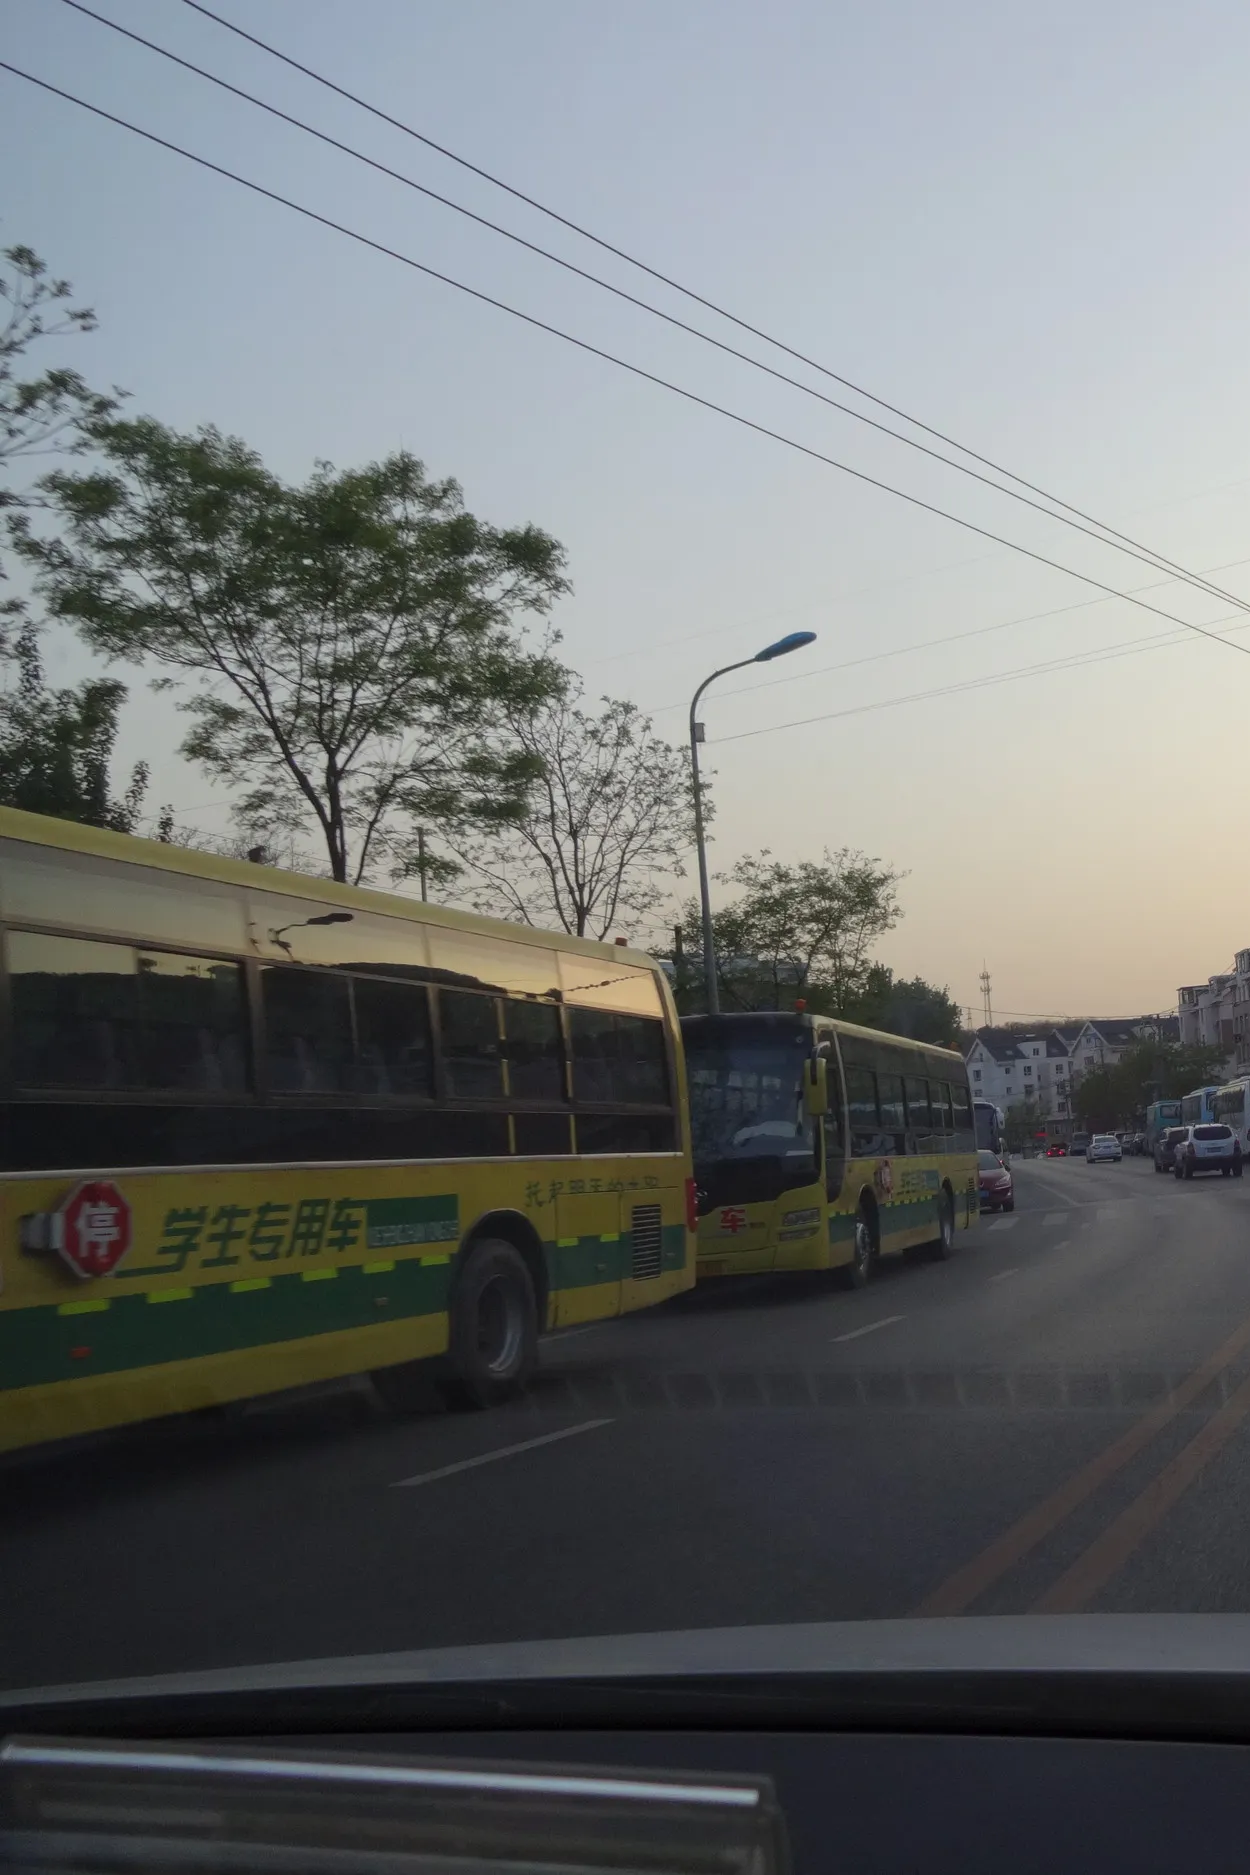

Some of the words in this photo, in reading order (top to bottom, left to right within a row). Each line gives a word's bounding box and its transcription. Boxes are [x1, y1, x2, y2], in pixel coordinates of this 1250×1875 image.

[74, 1199, 121, 1263] 停
[155, 1197, 367, 1273] 学生专用车
[720, 1206, 747, 1234] 车
